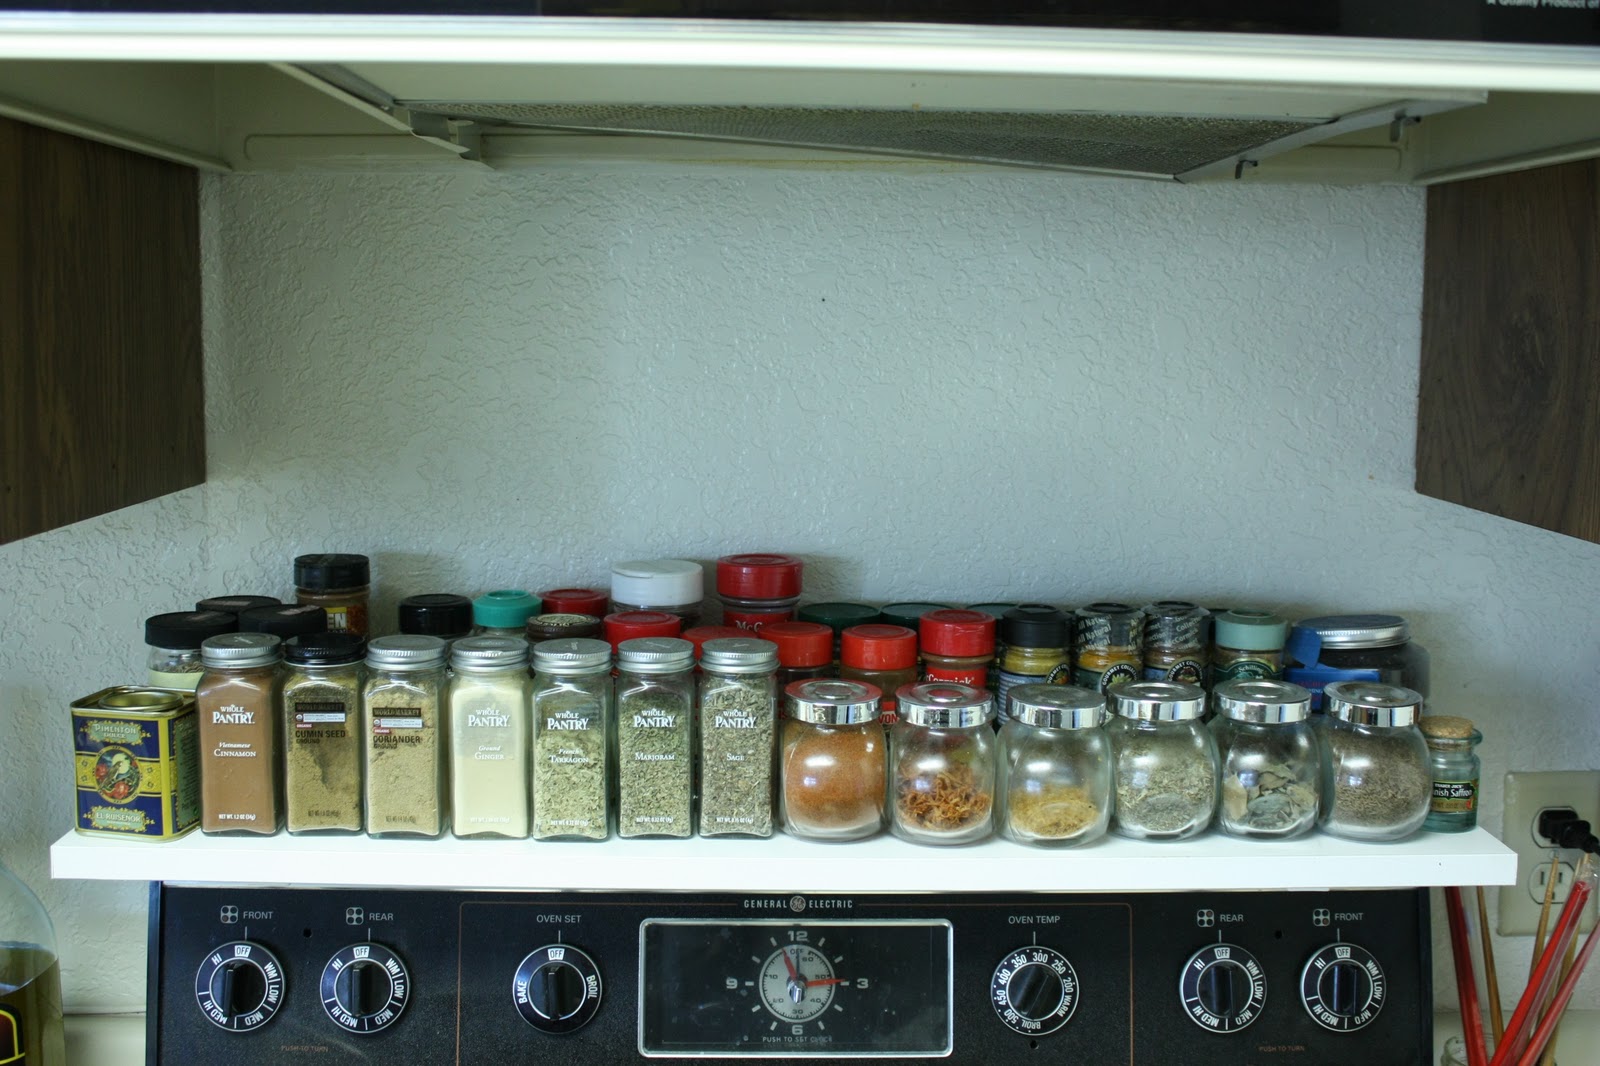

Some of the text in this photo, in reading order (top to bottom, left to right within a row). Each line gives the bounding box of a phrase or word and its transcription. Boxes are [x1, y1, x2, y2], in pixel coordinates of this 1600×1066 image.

[328, 613, 347, 628] EN
[735, 620, 763, 632] McC
[1102, 665, 1120, 686] GOURMET
[220, 704, 244, 712] WHOLE
[212, 711, 254, 724] PANTRY
[468, 715, 508, 727] PANTRY
[633, 716, 674, 728] PANTRY
[715, 716, 756, 728] PANTRY
[547, 718, 589, 730] PANTRY
[296, 730, 346, 738] CUMIN SEED
[373, 736, 421, 744] CORIANDER
[474, 752, 504, 760] GINGER
[634, 752, 674, 760] MARJORAM
[726, 753, 744, 761] SAGE
[1434, 788, 1472, 797] nish Saffron
[744, 900, 788, 908] GENERAL
[808, 900, 853, 908] ELECTRIC
[242, 911, 274, 920] FRONT
[368, 912, 394, 921] REAR
[536, 914, 582, 923] OVEN SET
[1008, 916, 1060, 924] OVEN TEMP
[1219, 914, 1244, 922] REAR
[1334, 912, 1364, 921] FRONT
[787, 930, 809, 942] 12
[236, 946, 250, 956] OFF
[355, 947, 369, 957] OFF
[550, 950, 563, 959] OFF
[1216, 948, 1230, 958] OFF
[1336, 948, 1350, 957] OFF
[211, 953, 223, 966] HI
[1011, 954, 1027, 969] 350
[1032, 952, 1048, 963] 300
[1314, 957, 1327, 970] HI
[332, 958, 344, 971] HI
[386, 958, 400, 978] WM
[1051, 959, 1066, 974] 250
[1193, 958, 1206, 971] HI
[1365, 959, 1380, 978] WM
[263, 961, 278, 982] WM
[998, 968, 1011, 986] 400
[394, 980, 404, 999] LOW
[586, 974, 598, 1000] BROIL
[726, 978, 738, 990] 9
[856, 978, 870, 990] 3
[1062, 976, 1074, 993] 200
[268, 984, 280, 1004] LOW
[518, 980, 528, 1004] BAKE
[1254, 981, 1264, 1000] LOW
[1373, 981, 1382, 1000] LOW
[996, 989, 1007, 1006] 450
[1056, 994, 1072, 1018] WARM
[203, 1000, 228, 1025] MED HI
[244, 1011, 264, 1026] MED
[331, 1006, 358, 1028] MED HI
[374, 1009, 394, 1026] MED
[1004, 1008, 1020, 1024] 500
[1192, 1004, 1220, 1028] MED HI
[1234, 1010, 1253, 1026] MED
[1312, 1003, 1339, 1027] MED HI
[791, 1024, 804, 1036] 6
[1021, 1020, 1041, 1030] BROIL
